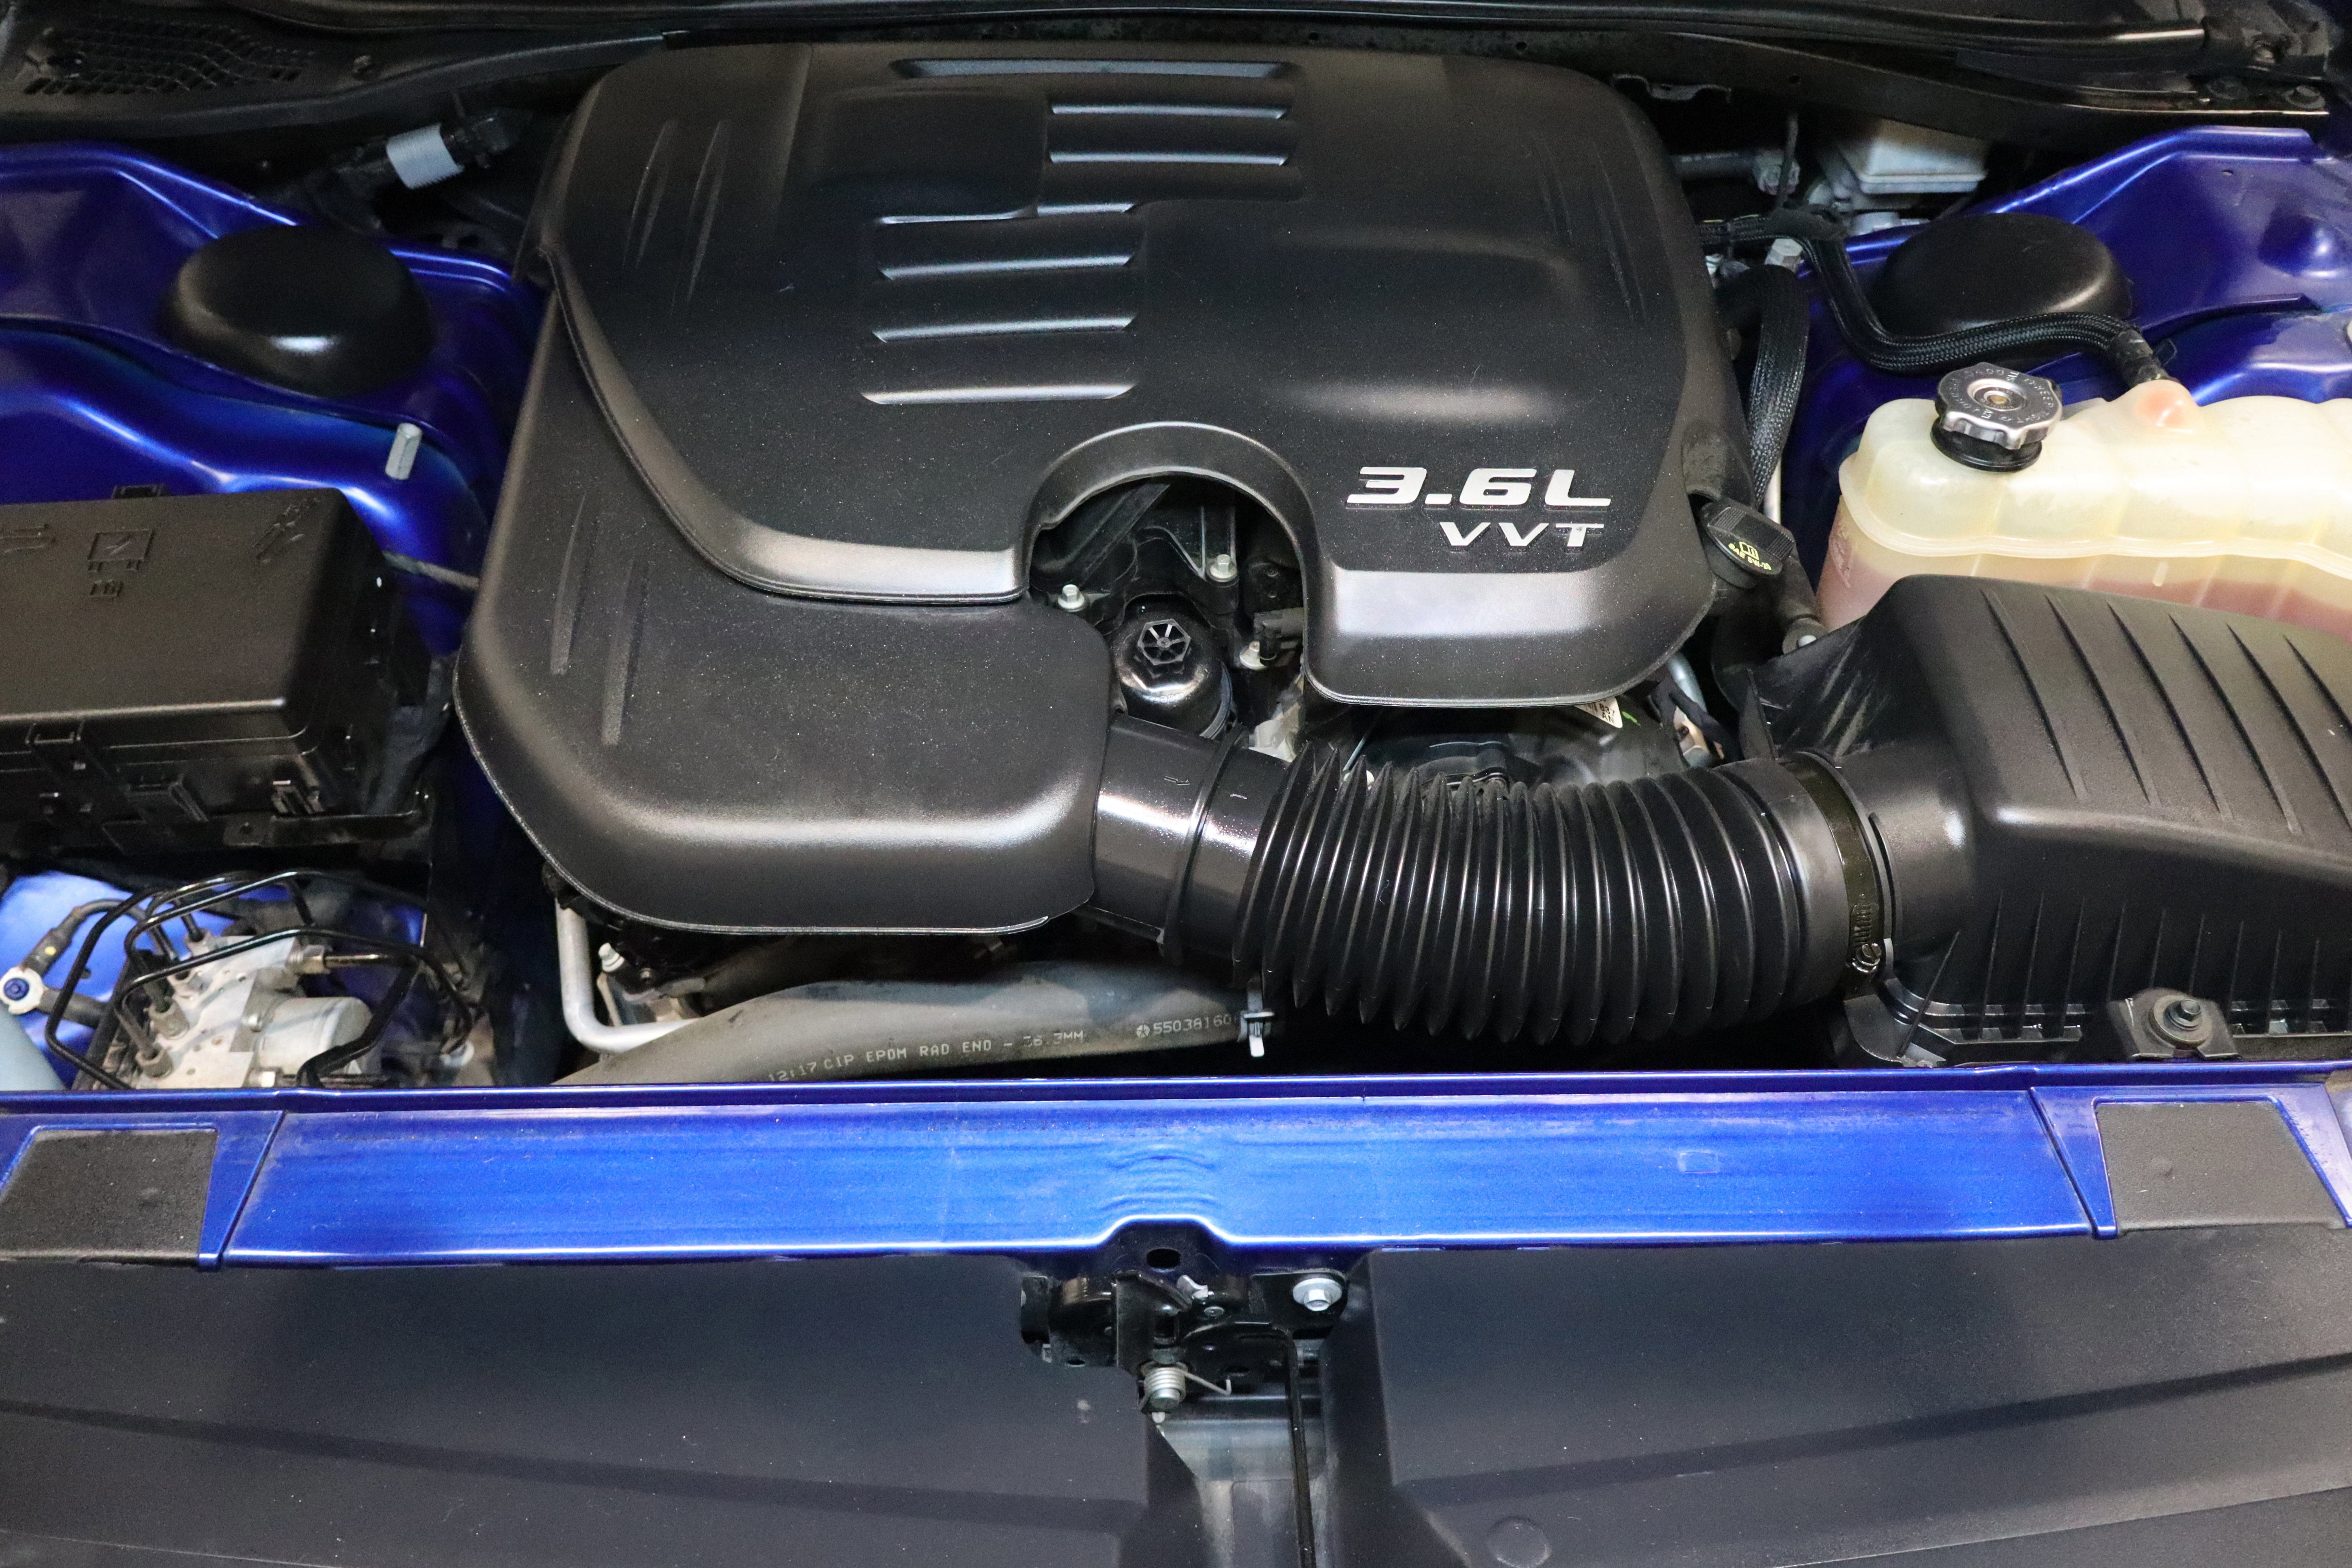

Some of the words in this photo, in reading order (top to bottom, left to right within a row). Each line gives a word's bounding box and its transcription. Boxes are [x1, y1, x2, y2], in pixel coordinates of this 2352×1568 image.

[1346, 466, 1611, 507] 3.6L
[1439, 521, 1605, 548] VVT
[1728, 543, 1745, 559] SAE
[1747, 556, 1771, 570] 5W-20
[823, 1054, 855, 1070] CIP
[866, 1047, 907, 1063] EPDM
[919, 1043, 950, 1057] RAD
[962, 1039, 992, 1053] END
[1153, 1013, 1237, 1035] 55038160
